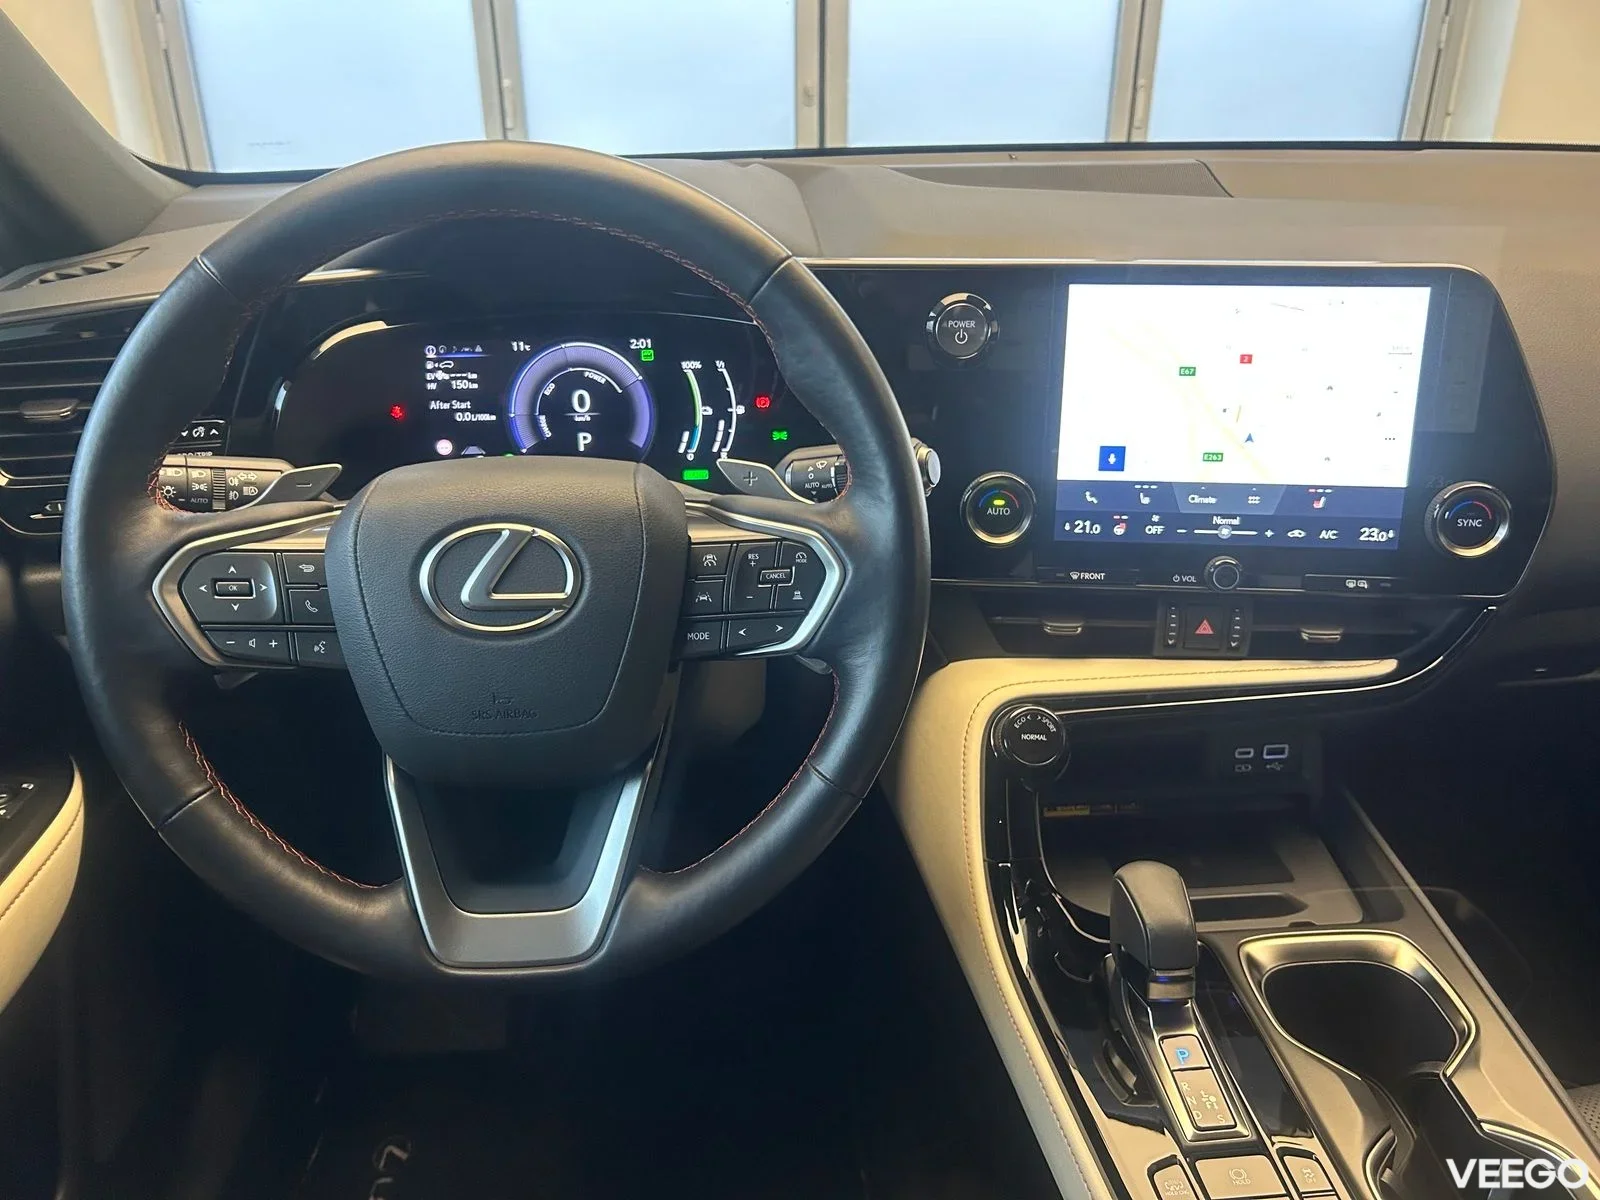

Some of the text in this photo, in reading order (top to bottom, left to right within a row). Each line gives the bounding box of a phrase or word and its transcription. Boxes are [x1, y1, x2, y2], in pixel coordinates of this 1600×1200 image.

[948, 320, 976, 328] POWER
[629, 338, 652, 350] 2:01
[583, 371, 607, 385] POWER
[429, 400, 472, 410] After Start
[571, 388, 592, 414] 0
[577, 432, 593, 452] P
[1188, 494, 1218, 504] Climate
[986, 507, 1011, 516] AUTO
[1212, 515, 1241, 526] Normal
[1457, 518, 1483, 527] SYNC
[1073, 519, 1101, 535] 21.0
[1145, 525, 1166, 535] OFF
[1319, 529, 1339, 540] A/C
[765, 572, 787, 580] CANCEL
[1080, 572, 1106, 581] FRONT
[1181, 575, 1197, 583] VOL
[687, 632, 710, 641] MODE
[494, 709, 539, 720] AIRBAG
[1013, 716, 1027, 729] ECO
[1041, 716, 1057, 732] SPORT
[1021, 733, 1047, 741] NORMAL
[1175, 1047, 1190, 1065] P
[1180, 1081, 1191, 1091] R
[1186, 1095, 1198, 1106] N
[1192, 1110, 1203, 1121] D
[1217, 1114, 1226, 1124] S
